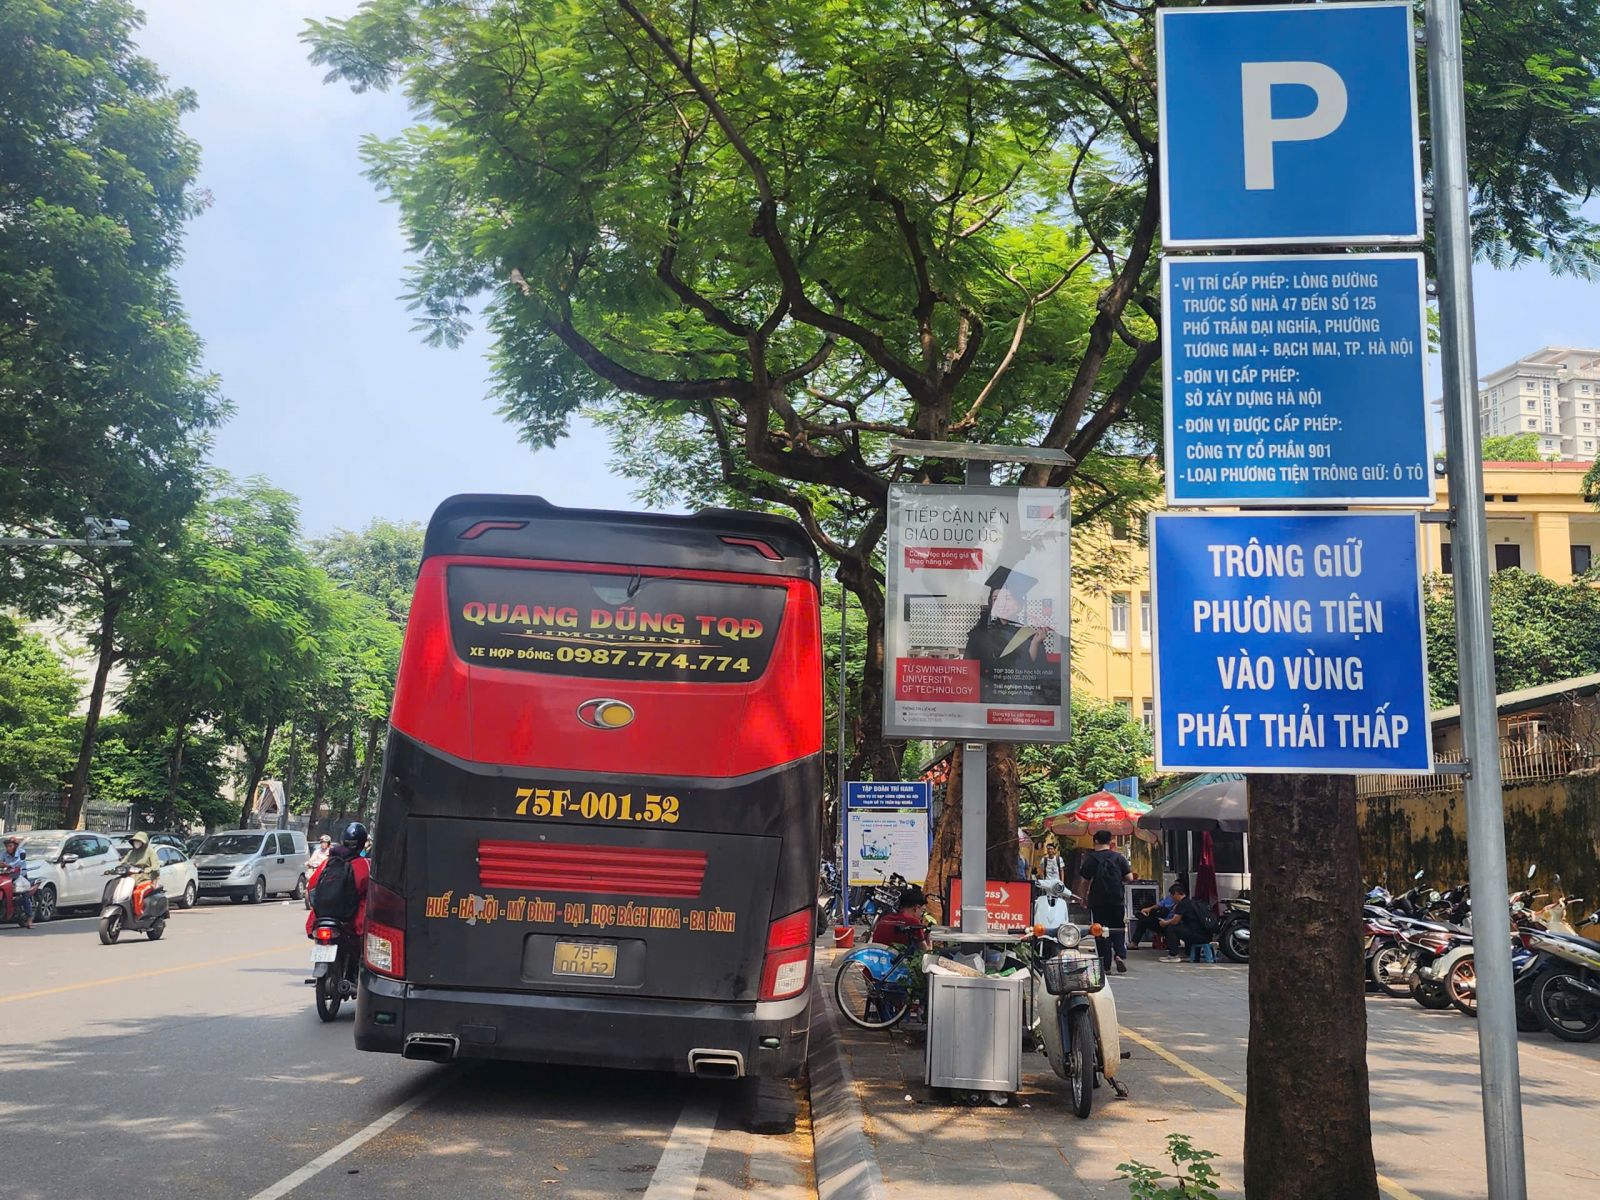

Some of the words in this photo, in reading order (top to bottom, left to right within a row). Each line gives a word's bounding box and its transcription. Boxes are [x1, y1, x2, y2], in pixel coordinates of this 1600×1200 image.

[1241, 61, 1347, 190] P
[1198, 275, 1218, 290] TRÍ
[1222, 272, 1247, 289] CẤP
[1252, 275, 1289, 289] PHÉP:
[1293, 272, 1327, 288] LÒNG
[1331, 271, 1378, 288] ĐƯỜNG
[1184, 295, 1225, 312] TRƯỚC
[1230, 294, 1247, 312] SỐ
[1252, 296, 1278, 311] NHÀ
[1282, 298, 1297, 311] 47
[1301, 293, 1327, 310] ĐẾN
[1331, 293, 1349, 310] SỐ
[1354, 297, 1376, 310] 125
[1183, 317, 1209, 335] PHỐ
[1213, 317, 1247, 334] TRẦN
[1251, 320, 1273, 336] ĐẠI
[1277, 318, 1321, 335] NGHĨA,
[1325, 316, 1380, 332] PHƯỜNG
[1184, 342, 1228, 357] TƯƠNG
[1233, 343, 1256, 356] MAI
[1274, 342, 1308, 358] BẠCH
[1312, 341, 1340, 357] MAI,
[1344, 341, 1364, 355] TP.
[1369, 338, 1386, 354] HÀ
[1391, 341, 1413, 357] NỘI
[1216, 370, 1228, 385] VỊ
[1232, 365, 1257, 382] CẤP
[1262, 367, 1300, 382] PHÉP:
[1185, 390, 1202, 406] SỞ
[1207, 390, 1231, 405] XÂY
[1237, 391, 1273, 408] DỰNG
[1277, 389, 1295, 405] HÀ
[1299, 388, 1321, 407] NỘI
[1218, 419, 1230, 435] VỊ
[1234, 418, 1270, 435] ĐƯỢC
[1274, 414, 1299, 431] CẤP
[1304, 414, 1342, 431] PHÉP:
[1187, 442, 1222, 459] CÔNG
[1226, 445, 1242, 458] TY
[1247, 439, 1264, 458] CỔ
[1269, 440, 1305, 458] PHẦN
[1309, 444, 1331, 457] 901
[1221, 467, 1275, 481] PHƯƠNG
[1279, 465, 1309, 484] TIỆN
[1312, 464, 1357, 480] TRÔNG
[1362, 465, 1389, 480] GIỮ:
[1394, 463, 1402, 480] Ô
[1406, 463, 1423, 480] TÔ
[905, 506, 938, 523] TIẾP
[942, 508, 973, 525] CẬN
[978, 506, 1009, 524] NỀN
[905, 527, 939, 541] GIÁO
[944, 529, 973, 544] DỤC
[1208, 537, 1303, 577] TRÔNG
[1314, 537, 1362, 577] GIỮ
[463, 602, 578, 627] QUANG
[590, 607, 684, 634] DŨNG
[696, 616, 763, 639] TQĐ
[1194, 595, 1312, 633] PHƯƠNG
[1320, 593, 1383, 641] TIỆN
[525, 629, 701, 644] LIMOUSINE
[470, 648, 484, 657] XE
[489, 647, 514, 660] HỢP
[518, 648, 553, 661] ĐỒNG:
[557, 647, 750, 672] 0987.774.774
[916, 665, 968, 674] SWINBURNE
[1217, 649, 1274, 690] VÀO
[1284, 649, 1363, 690] VÙNG
[903, 675, 952, 683] UNIVERSITY
[902, 685, 913, 693] OF
[916, 686, 972, 695] TECHNOLOGY
[1178, 705, 1251, 747] PHÁT
[1260, 703, 1324, 747] THẢI
[1334, 702, 1408, 748] THẤP
[515, 787, 680, 823] 75F-001.52
[426, 891, 454, 918] HUẾ
[459, 894, 476, 918] HÀ
[507, 896, 526, 920] MỸ
[528, 897, 556, 922] ĐÌNH
[591, 904, 616, 928] HỌC
[617, 901, 648, 927] BÁCH
[650, 907, 680, 929] KHOA
[690, 911, 705, 930] BA
[708, 907, 736, 932] ĐÌNH
[574, 946, 599, 960] 75F
